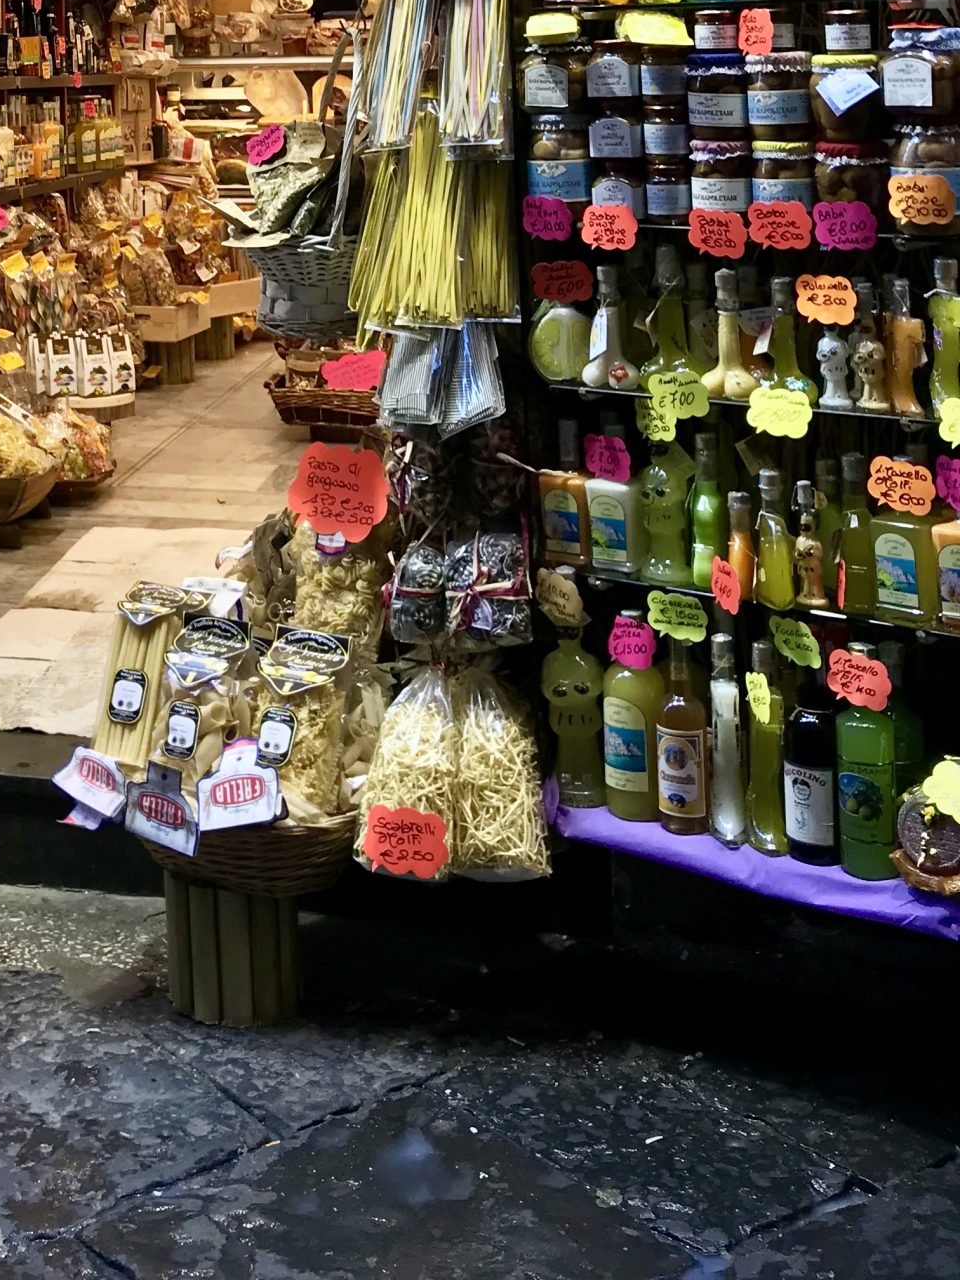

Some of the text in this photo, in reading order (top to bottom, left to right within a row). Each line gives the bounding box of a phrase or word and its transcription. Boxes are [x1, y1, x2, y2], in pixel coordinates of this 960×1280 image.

[308, 456, 340, 473] Pasta
[214, 777, 261, 804] FAELLA
[142, 794, 183, 826] FAELLA
